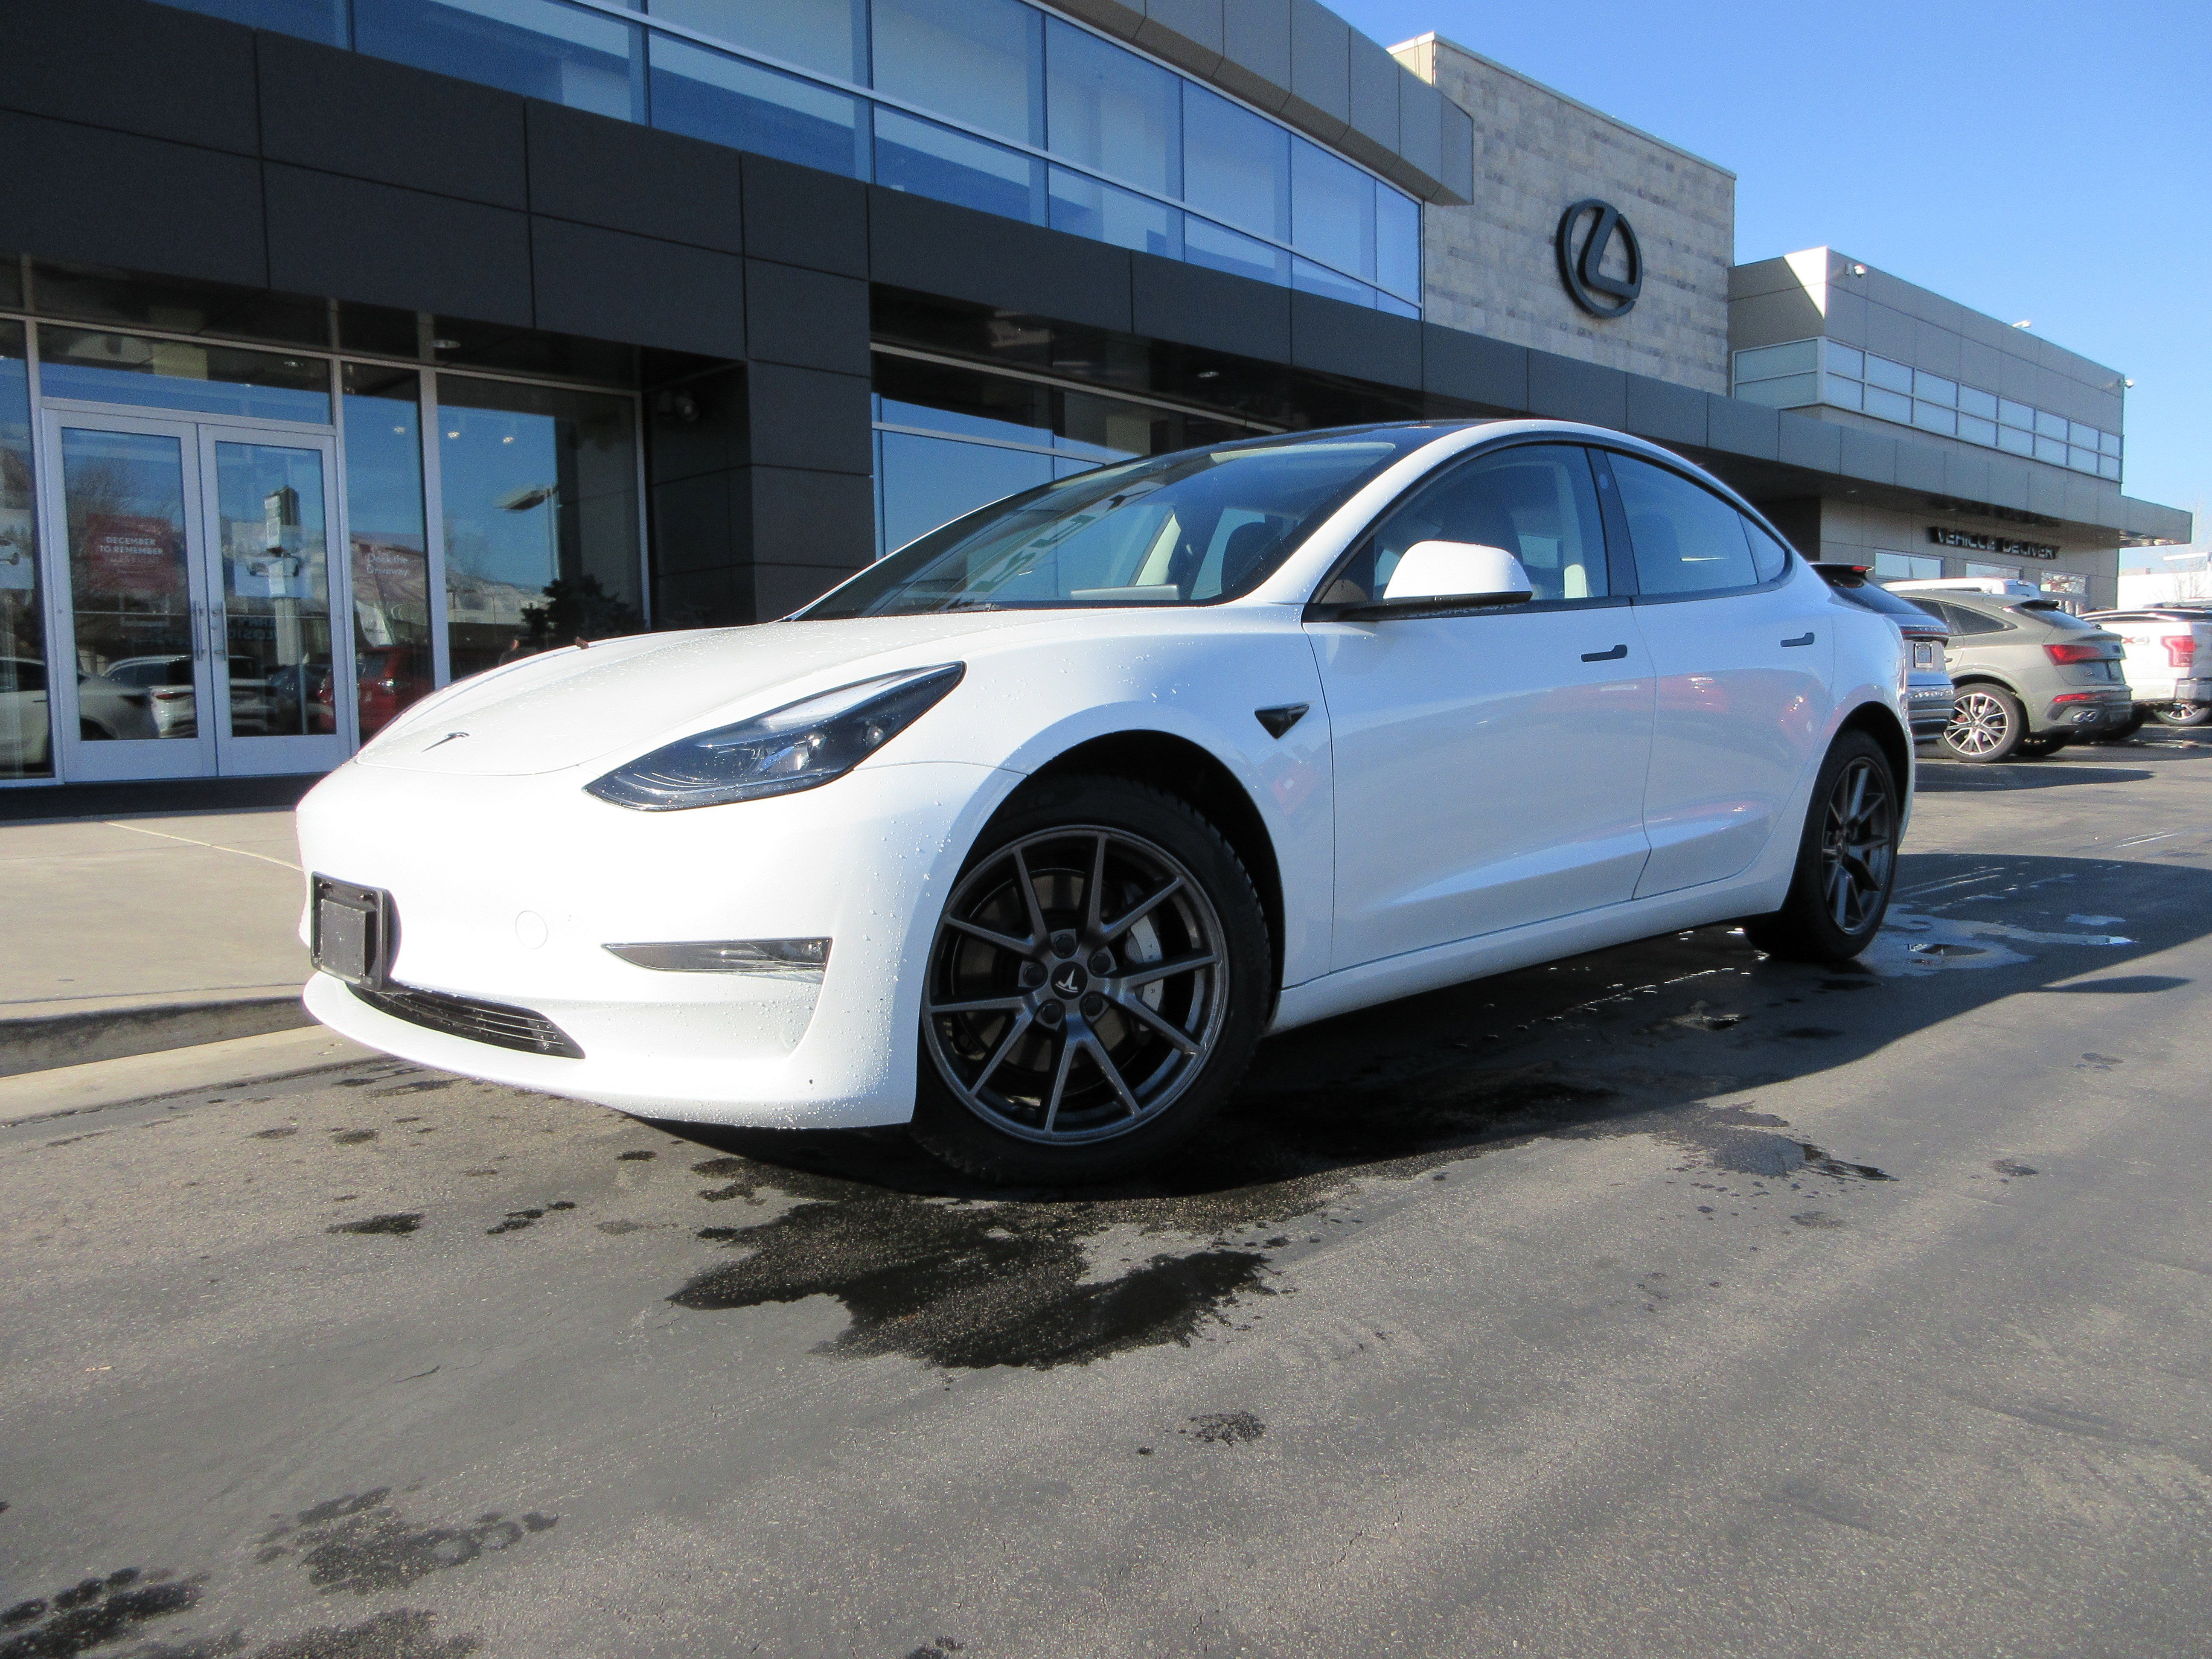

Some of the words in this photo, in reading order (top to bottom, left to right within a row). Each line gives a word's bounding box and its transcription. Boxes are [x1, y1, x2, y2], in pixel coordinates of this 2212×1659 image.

[106, 536, 156, 545] DECEMBER
[1930, 528, 1997, 550] VEHICLE
[113, 546, 163, 555] REMEMBER
